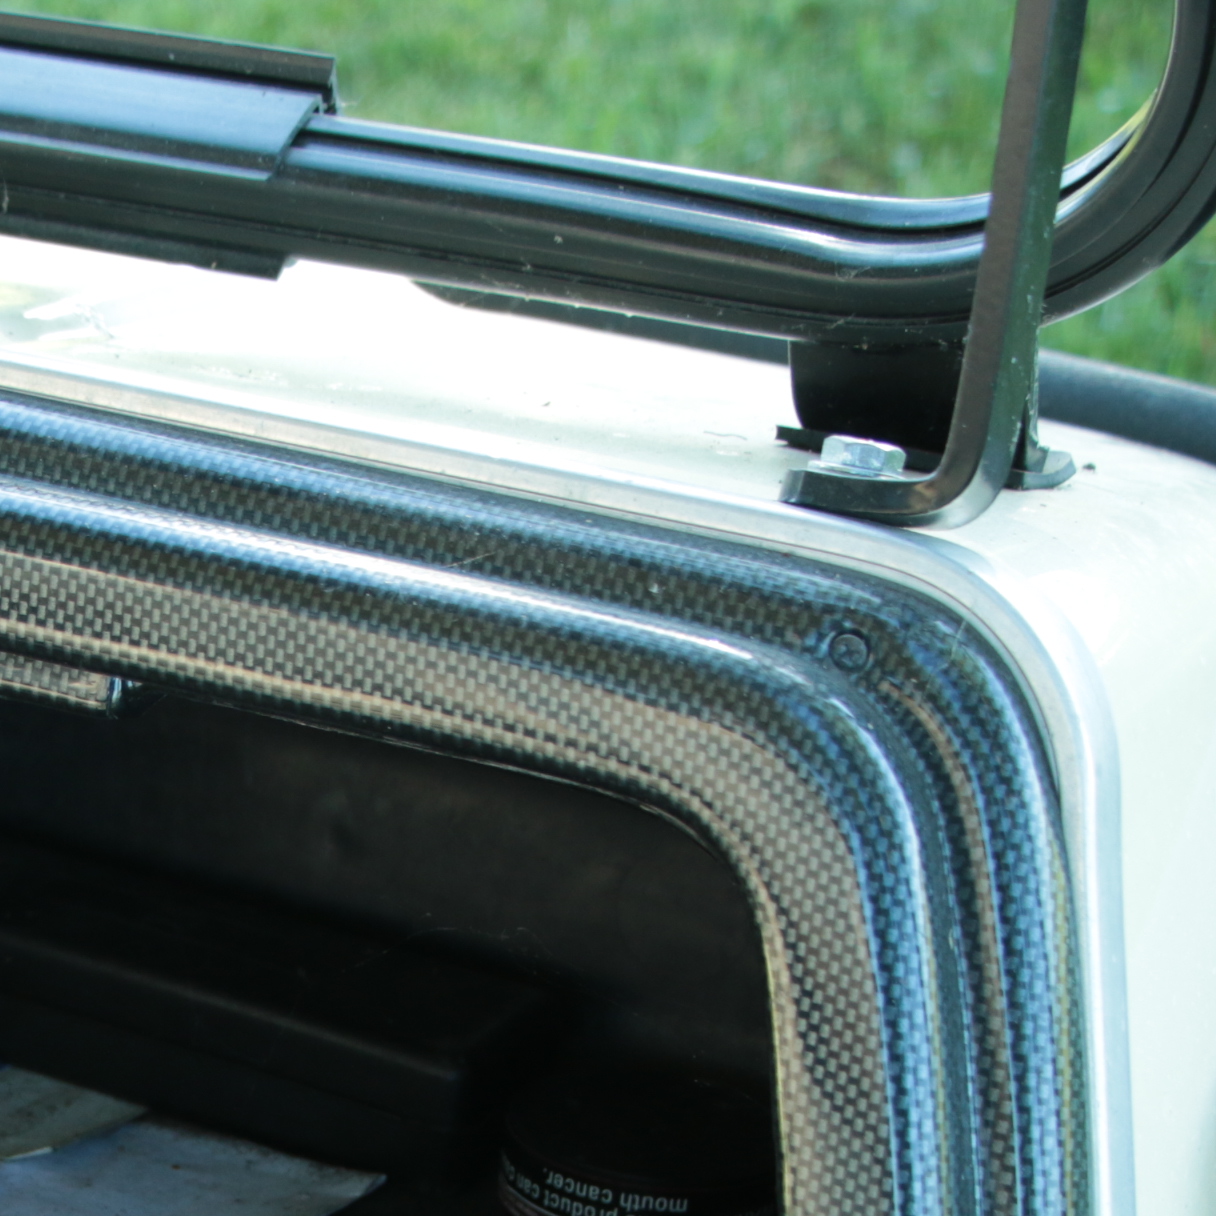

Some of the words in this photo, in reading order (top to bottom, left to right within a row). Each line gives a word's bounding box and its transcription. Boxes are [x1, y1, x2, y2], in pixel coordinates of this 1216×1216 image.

[516, 1171, 541, 1200] can
[542, 1167, 613, 1204] cancer.
[619, 1191, 689, 1214] mouth
